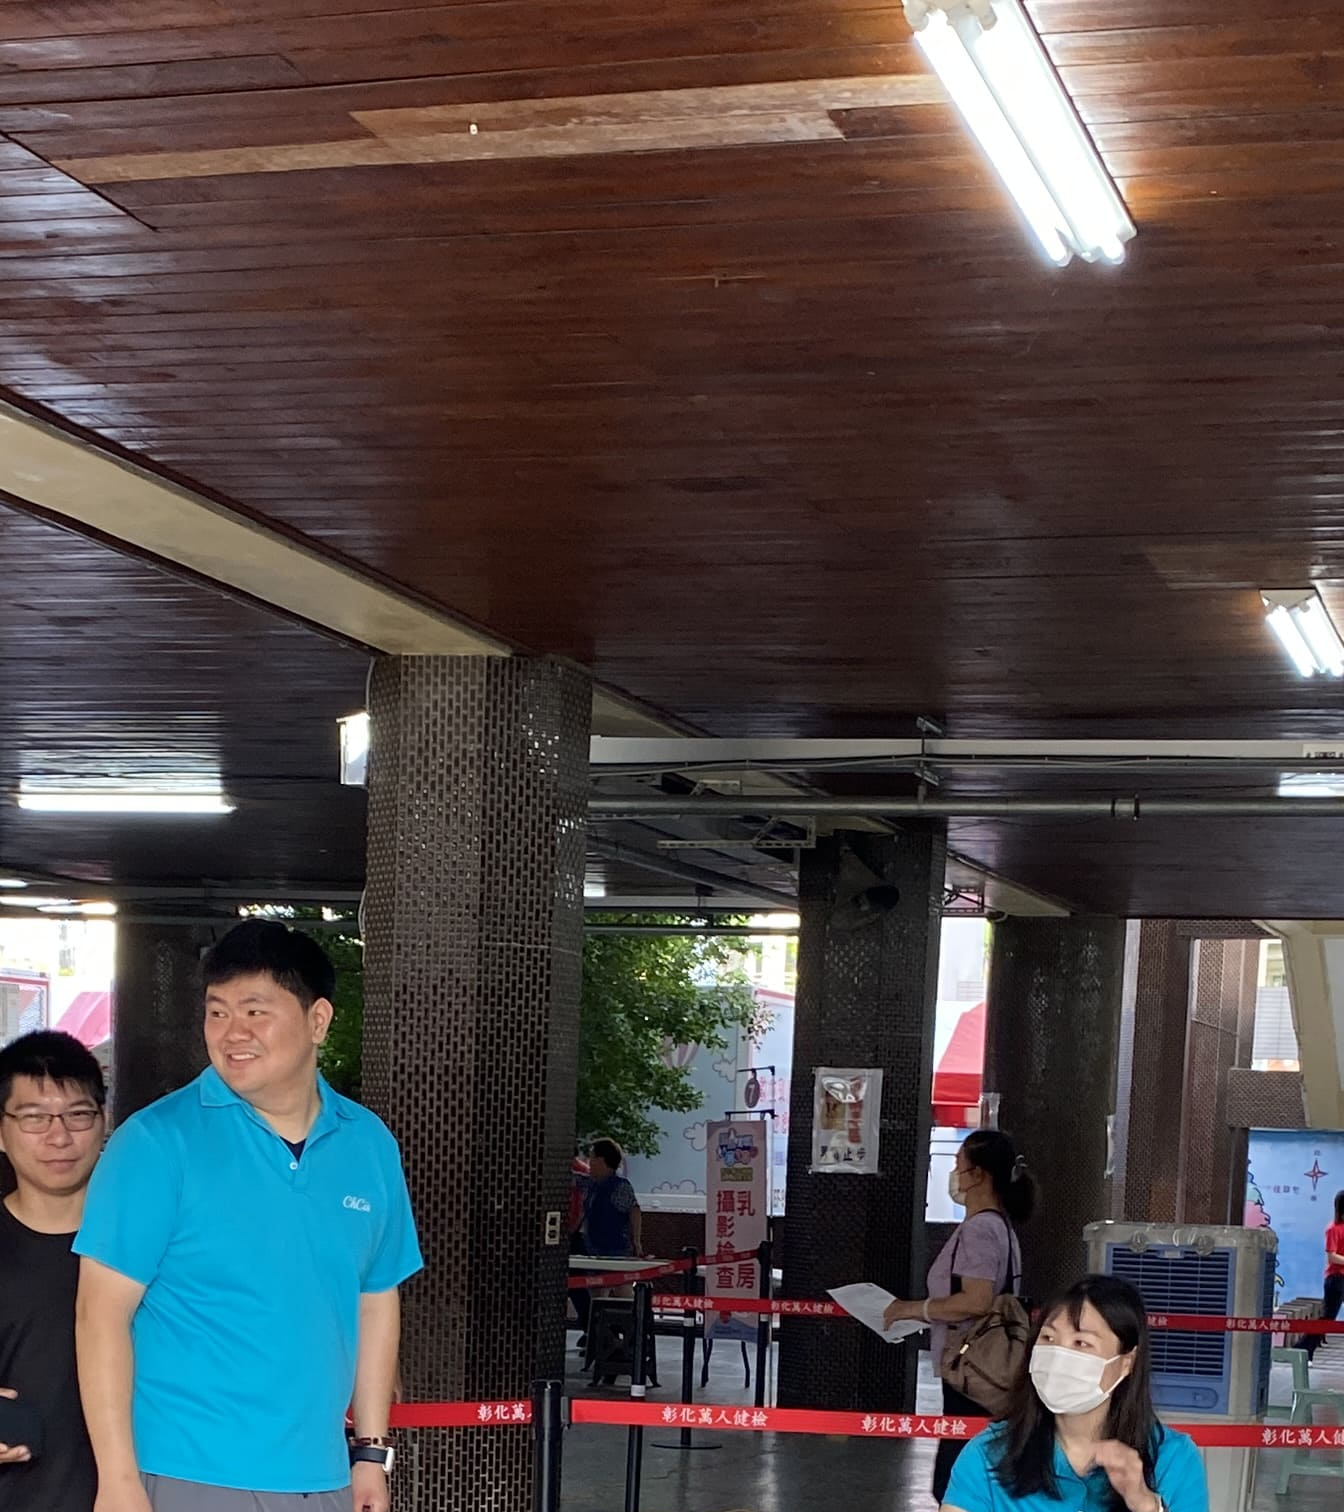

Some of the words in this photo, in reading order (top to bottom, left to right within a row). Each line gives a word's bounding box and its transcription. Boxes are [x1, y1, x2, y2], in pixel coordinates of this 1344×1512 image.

[748, 1083, 756, 1106] 7
[736, 1191, 755, 1289] 乳房
[477, 1403, 532, 1421] 彰化萬
[661, 1405, 768, 1427] 彰化萬人健檢
[860, 1413, 968, 1436] 彰化萬人健檢
